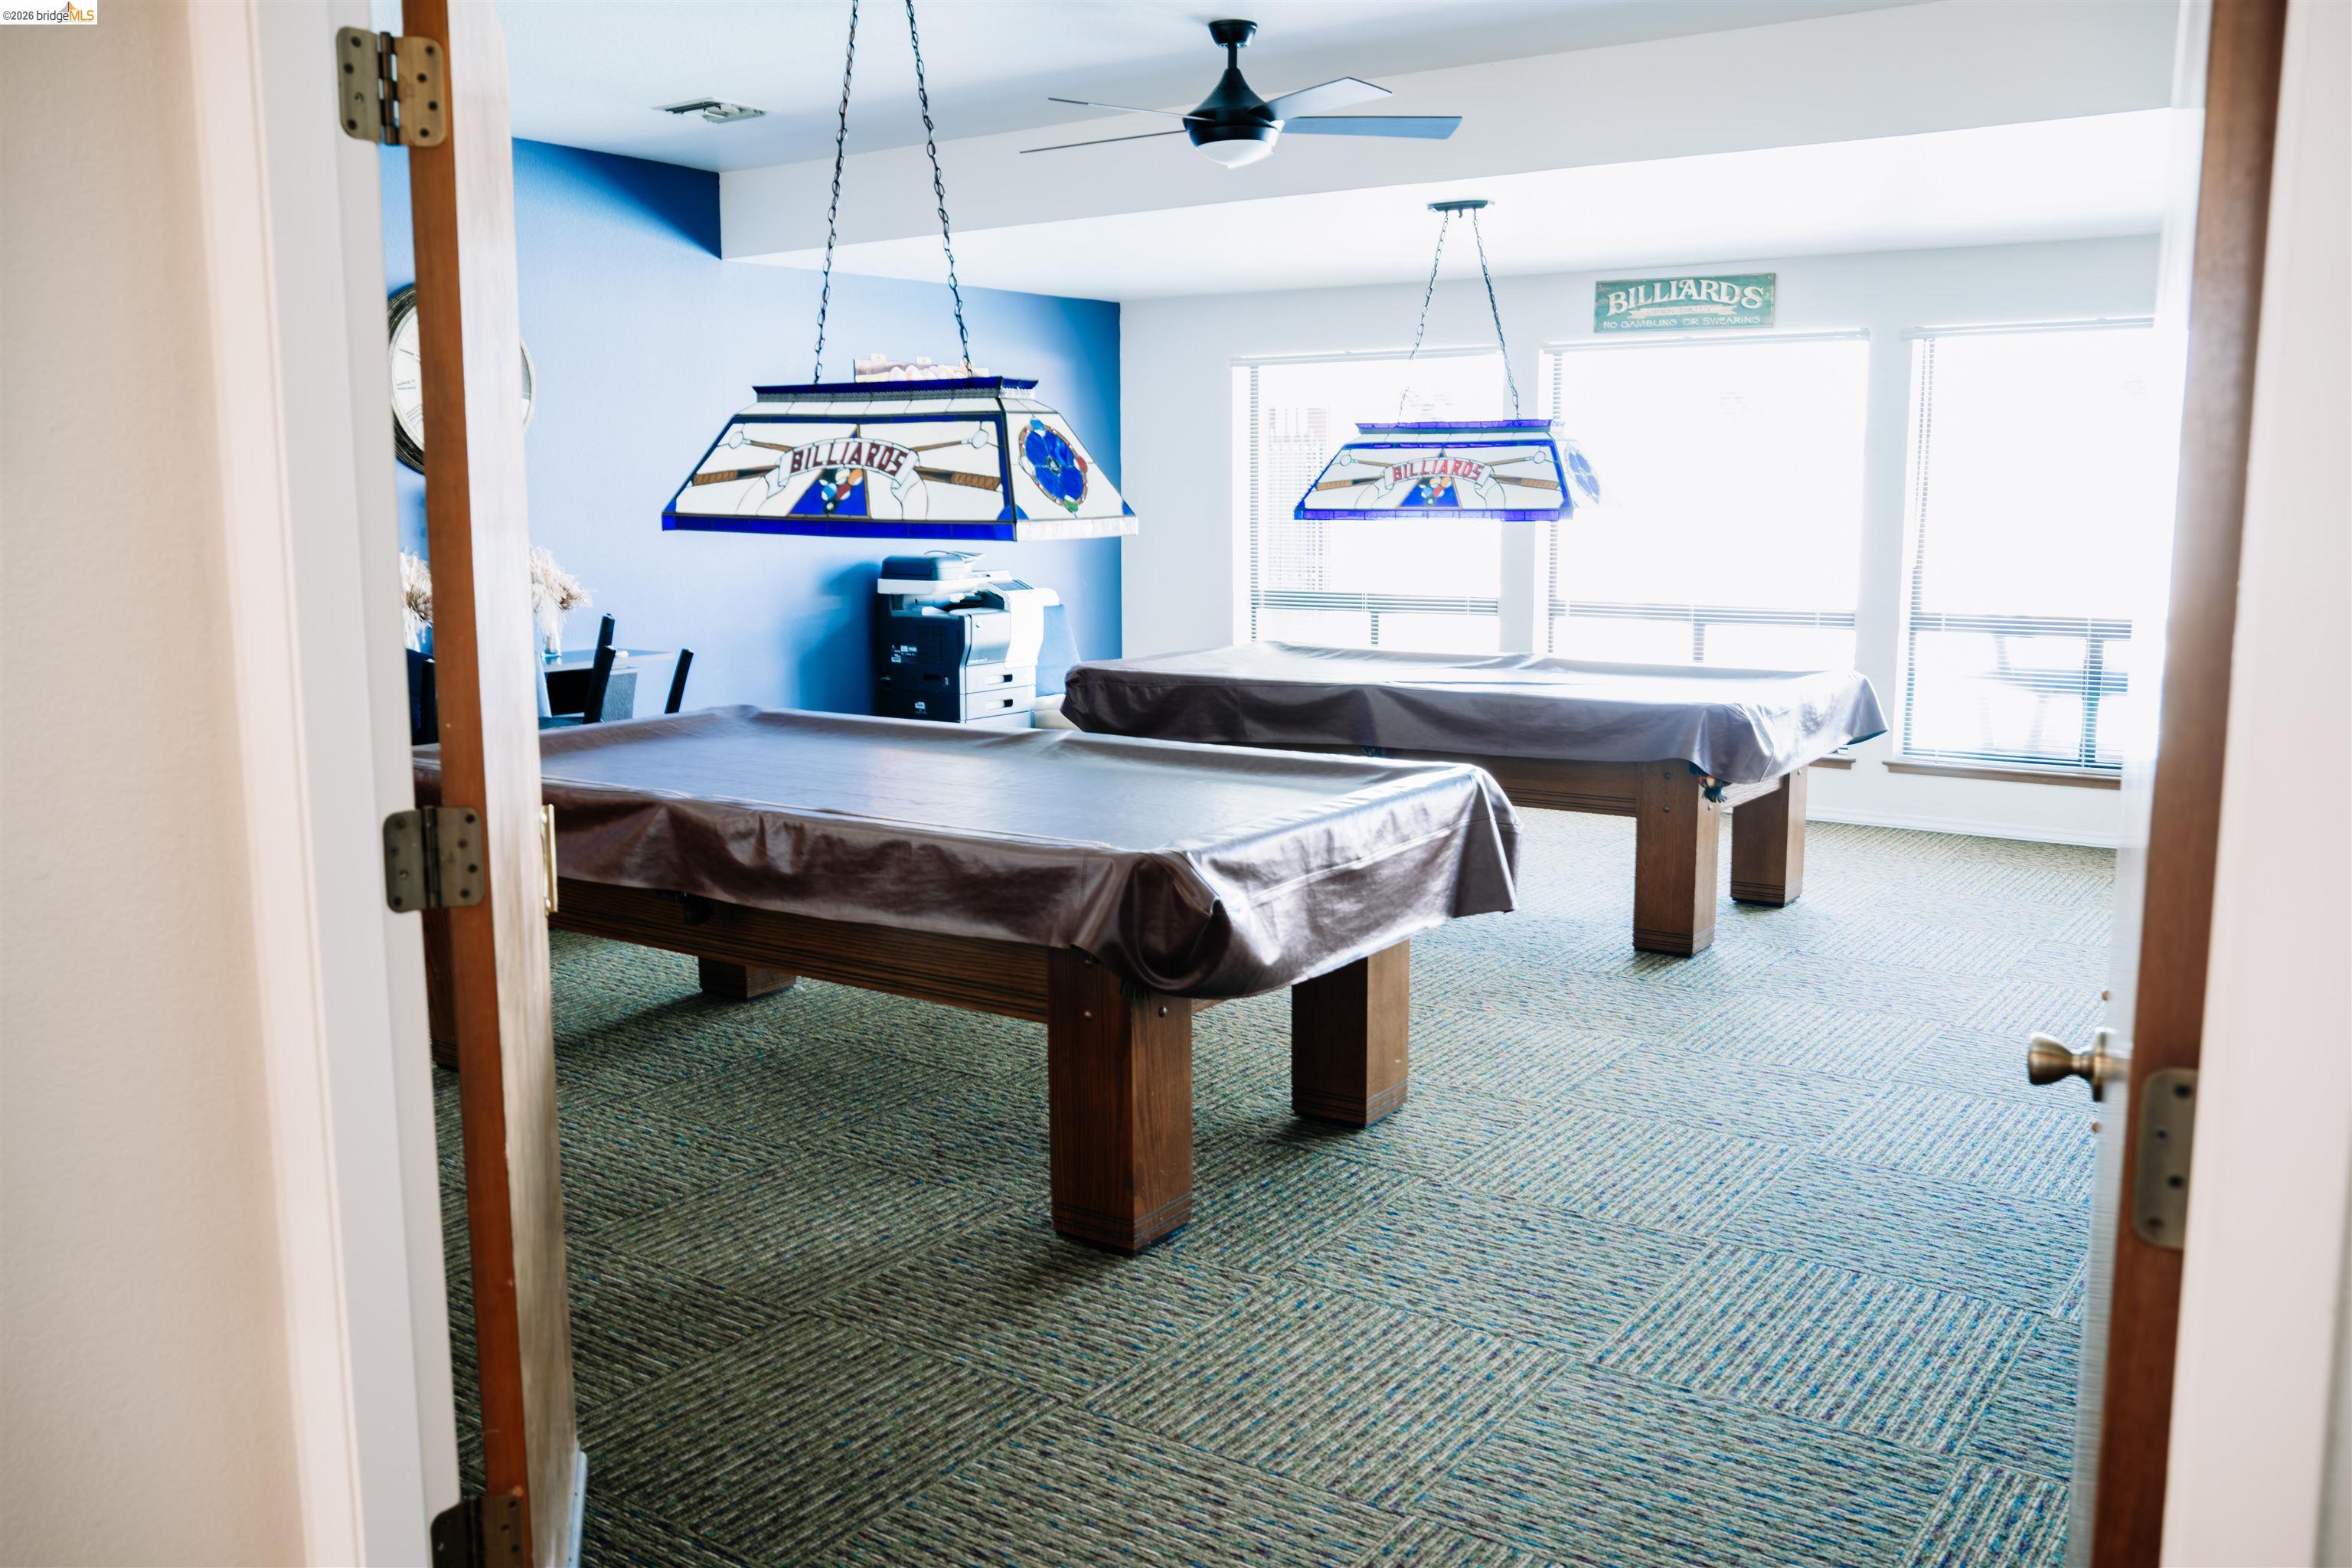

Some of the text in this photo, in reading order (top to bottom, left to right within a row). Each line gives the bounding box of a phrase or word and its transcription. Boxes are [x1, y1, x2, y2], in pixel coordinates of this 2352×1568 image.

[1606, 279, 1765, 316] BILLIARDS
[1603, 321, 1618, 329] NO
[1621, 318, 1677, 328] GAMBLING
[1682, 318, 1700, 326] OR
[791, 442, 909, 477] BILLIARDS
[1392, 459, 1485, 482] BILLIARDS
